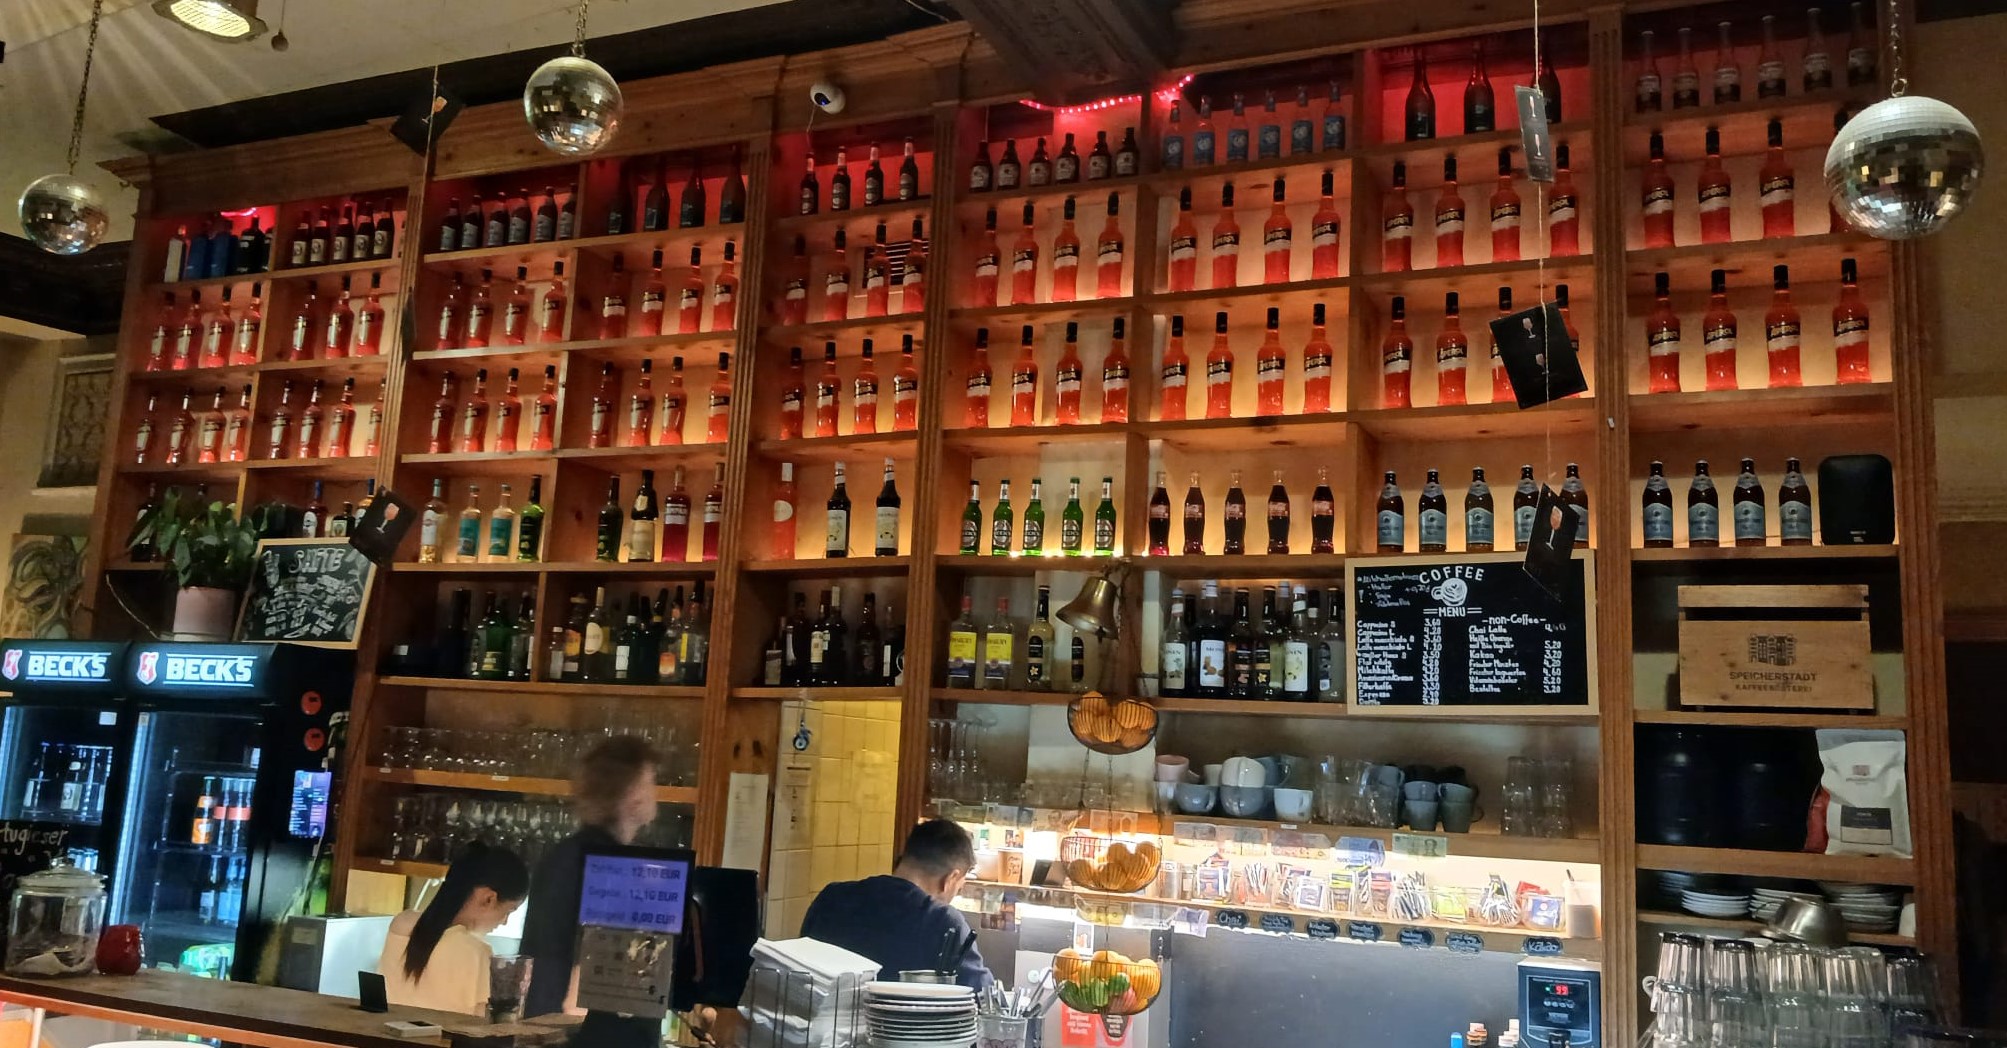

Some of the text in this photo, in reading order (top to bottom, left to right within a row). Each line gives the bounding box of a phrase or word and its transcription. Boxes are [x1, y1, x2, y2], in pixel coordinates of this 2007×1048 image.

[1419, 565, 1484, 584] COFFEE
[1438, 606, 1466, 617] MENU
[1469, 649, 1494, 658] Kakao
[1729, 671, 1817, 681] SPEICHERSTADT
[660, 869, 681, 880] EUR
[658, 891, 679, 902] EUR
